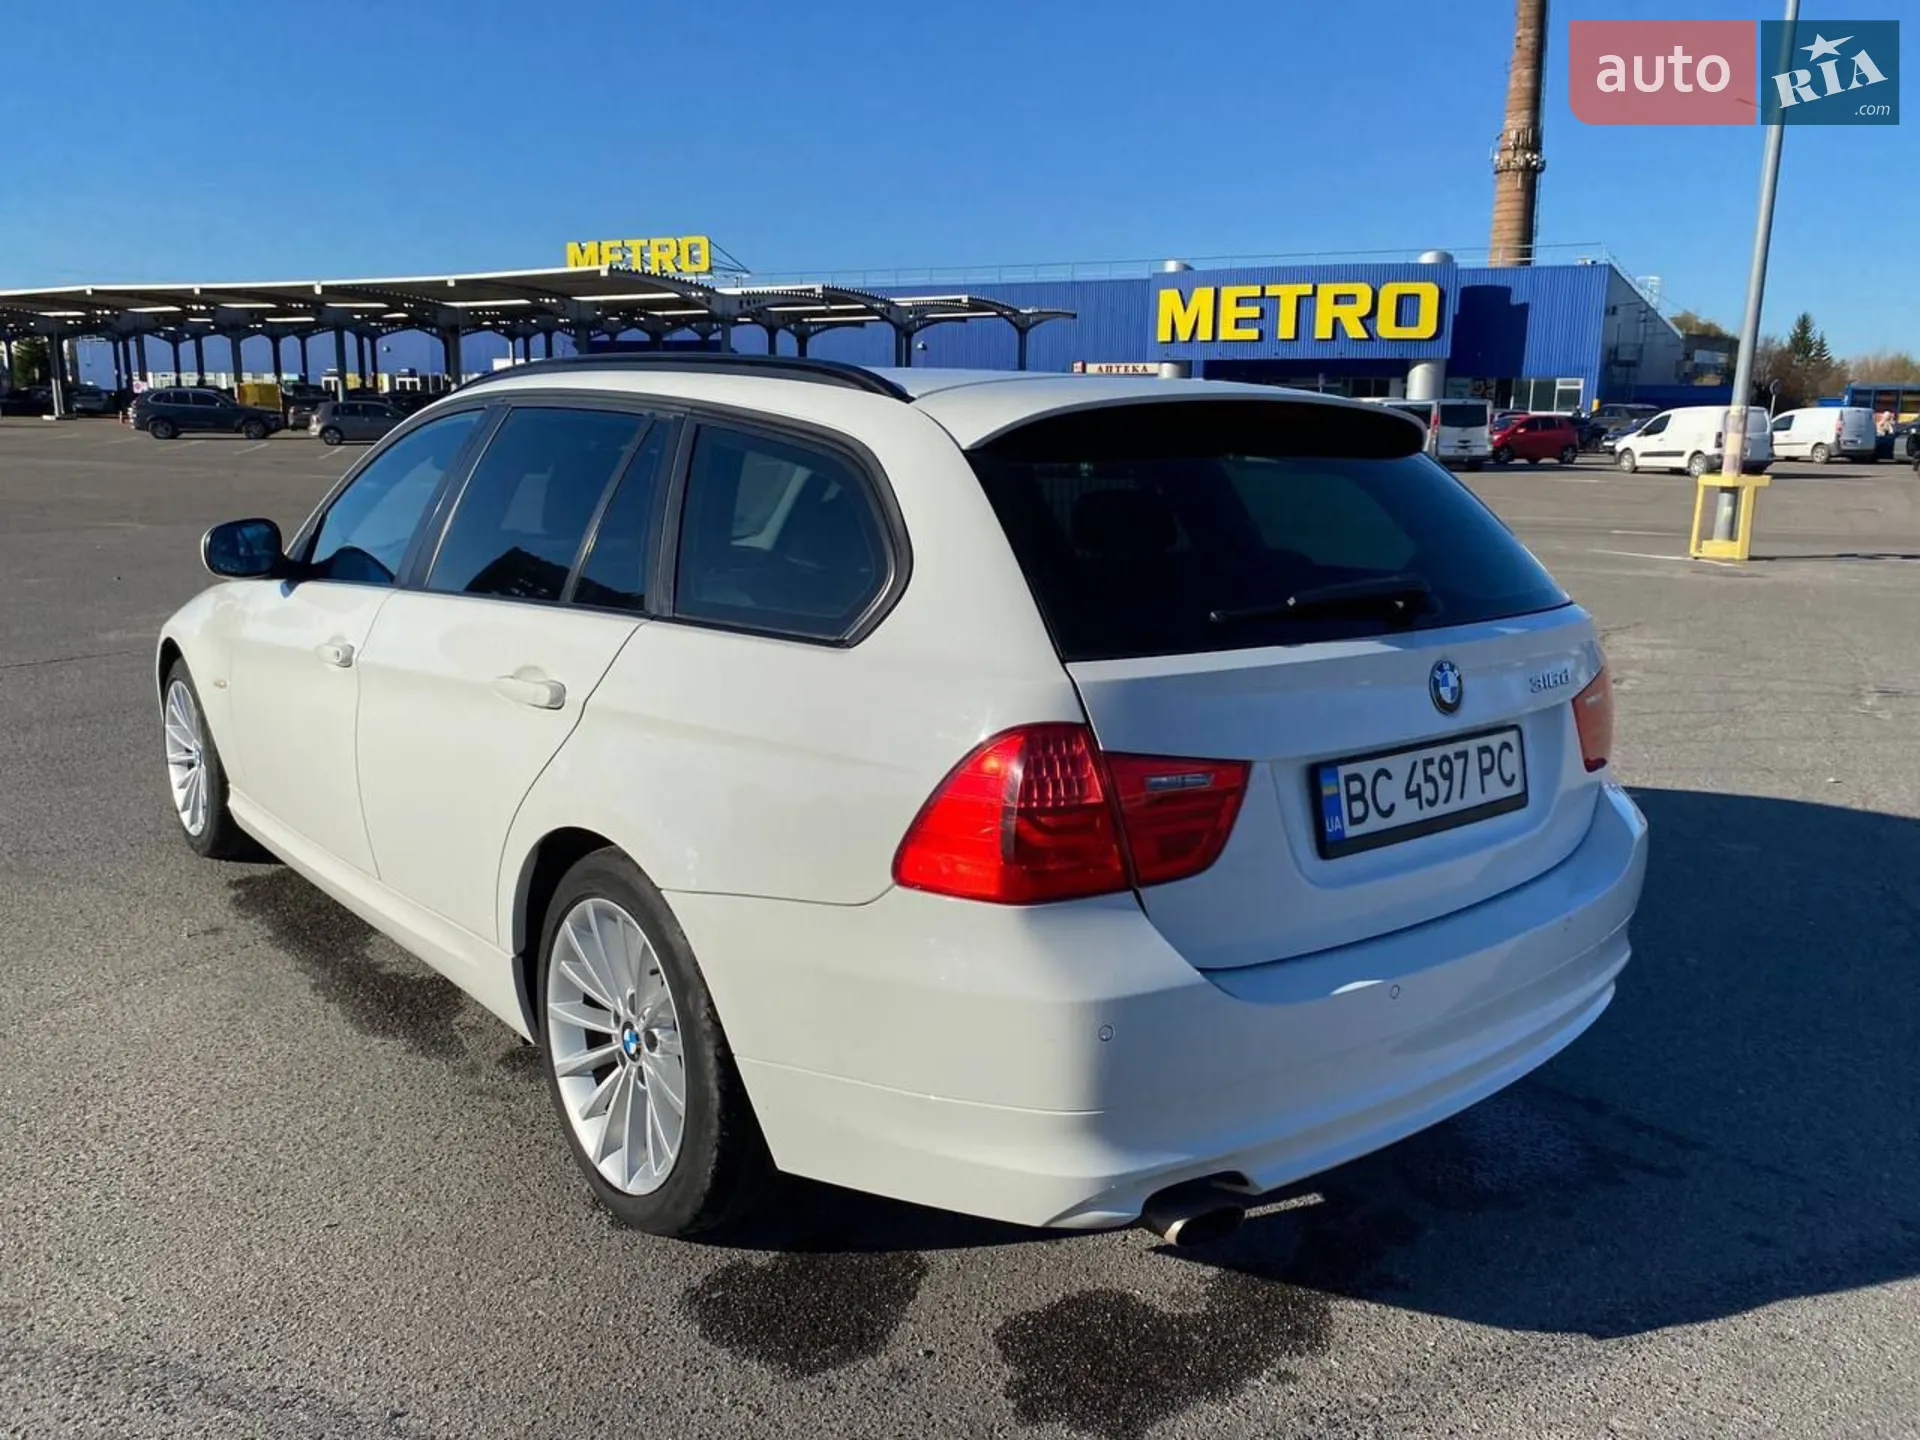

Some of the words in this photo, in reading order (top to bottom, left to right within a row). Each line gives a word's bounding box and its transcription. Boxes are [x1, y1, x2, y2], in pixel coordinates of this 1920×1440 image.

[566, 235, 711, 274] METRO
[1157, 281, 1440, 343] METRO
[1096, 364, 1149, 374] АПТЕКА
[1344, 767, 1396, 827] BC
[1404, 751, 1469, 811] 4597
[1477, 741, 1516, 795] PC
[1325, 817, 1342, 833] UA
